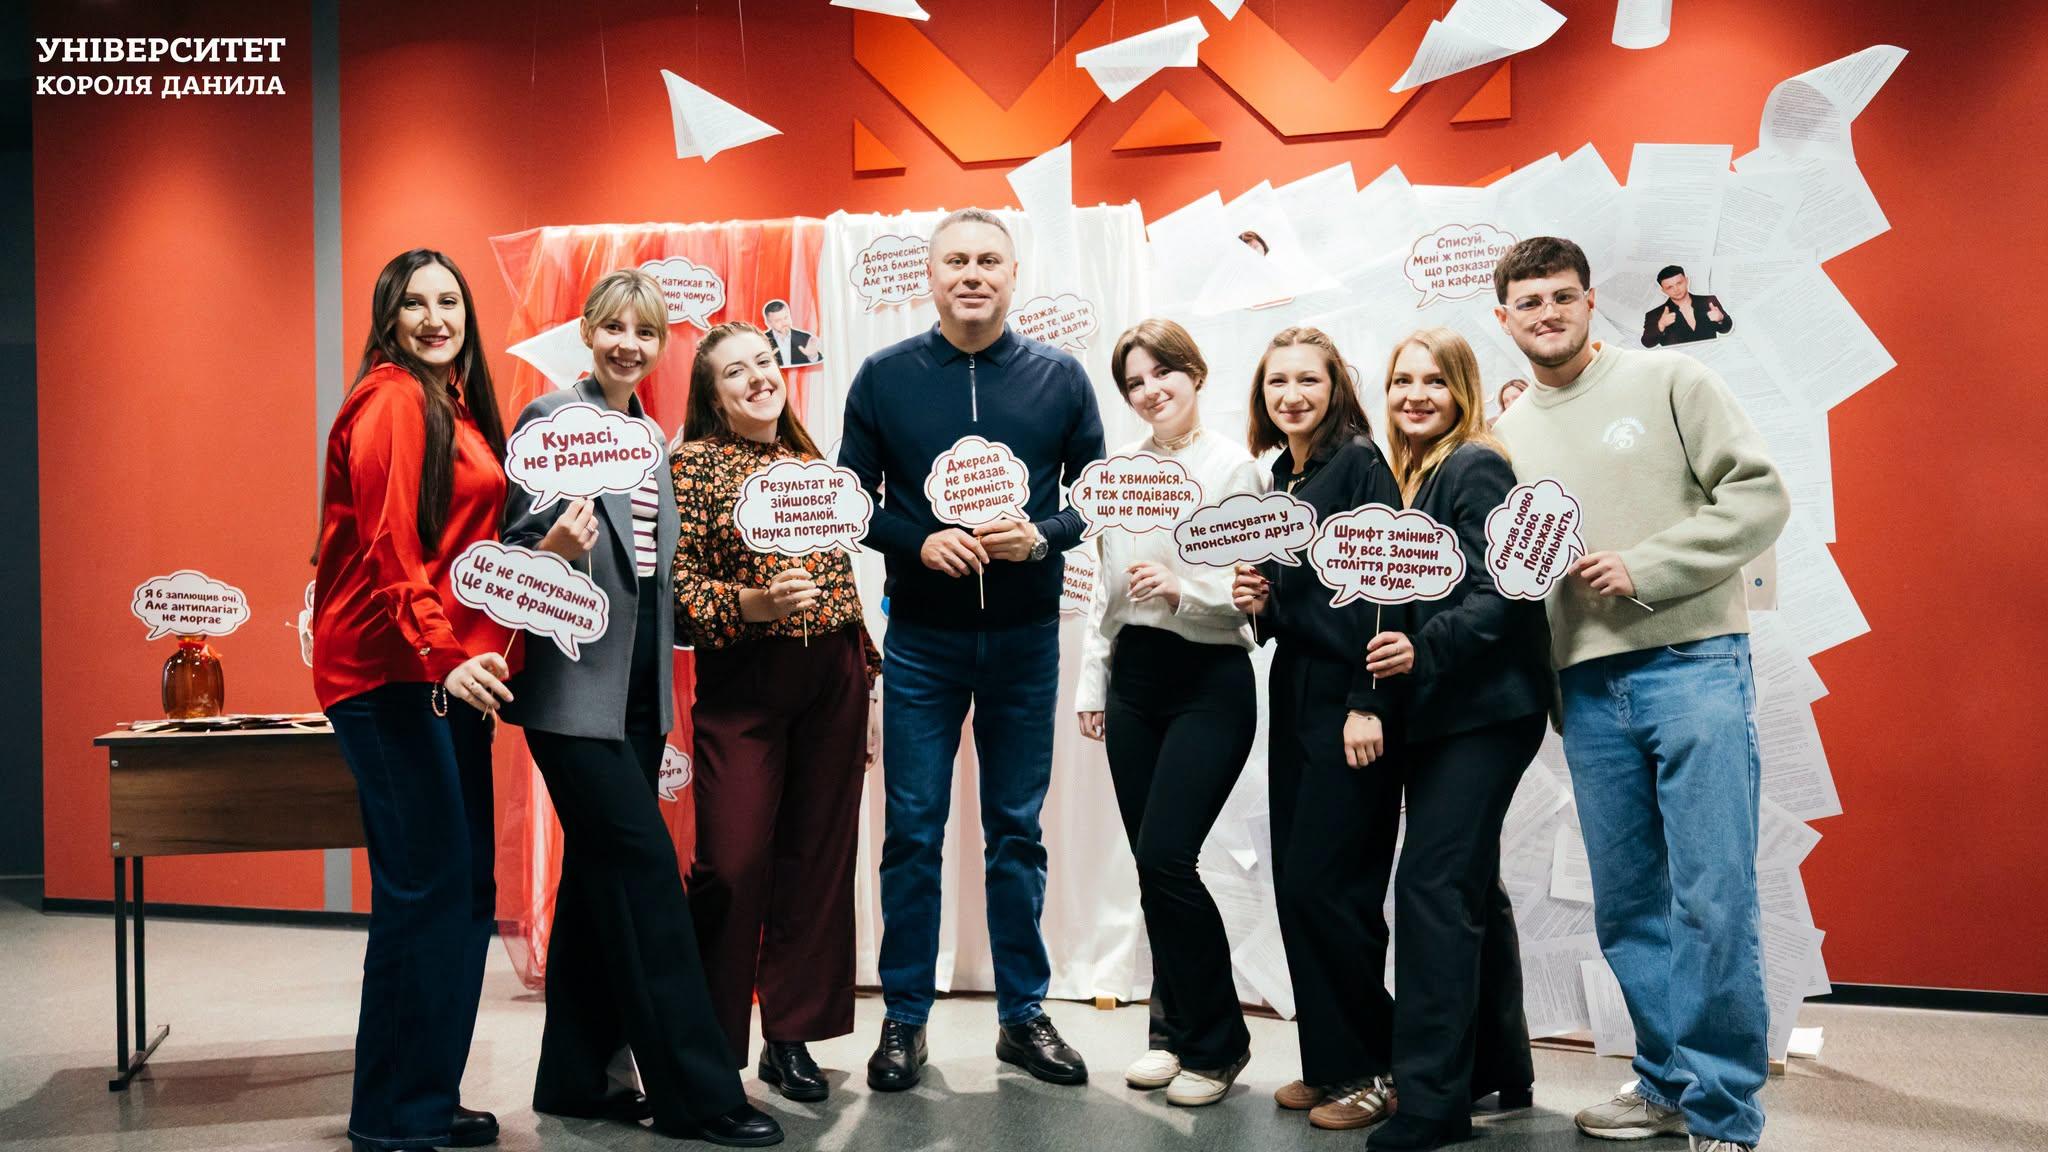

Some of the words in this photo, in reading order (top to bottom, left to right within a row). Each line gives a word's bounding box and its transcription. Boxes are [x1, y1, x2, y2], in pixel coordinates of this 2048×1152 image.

[1437, 232, 1486, 249] Списуй.
[1413, 251, 1439, 266] Мені
[1442, 252, 1452, 262] ж
[1454, 247, 1485, 260] потім
[865, 264, 888, 276] була
[1425, 267, 1442, 277] що
[1446, 259, 1498, 275] розказат
[662, 277, 703, 288] натискав
[863, 277, 881, 287] Але
[883, 275, 895, 283] ти
[896, 282, 922, 295] туди.
[1431, 279, 1445, 289] на
[1448, 273, 1492, 287] кафедр
[683, 291, 716, 304] чомусь
[1061, 313, 1076, 323] що
[1078, 307, 1089, 315] ти
[1048, 329, 1060, 340] це
[542, 426, 618, 452] Кумасі,
[524, 455, 548, 470] не
[554, 447, 652, 472] радимось
[946, 453, 1000, 474] Джерела
[945, 475, 960, 487] не
[963, 465, 1009, 484] вказав.
[1100, 471, 1116, 484] Не
[1119, 471, 1184, 485] хвилюйся.
[760, 478, 825, 494] Результат
[829, 477, 844, 489] не
[943, 479, 1015, 502] Скромність
[771, 491, 838, 509] зійшовся?
[1082, 486, 1092, 500] Я
[1095, 489, 1118, 500] теж
[1122, 487, 1195, 503] сподівався,
[949, 493, 1016, 516] прикрашає
[1097, 506, 1115, 518] що
[1119, 506, 1133, 515] не
[1136, 503, 1180, 520] помічу
[774, 507, 838, 524] Намалюй.
[1190, 526, 1207, 537] Не
[1209, 513, 1276, 534] списувати
[1279, 510, 1289, 522] у
[752, 527, 791, 542] Наука
[794, 522, 861, 538] потерпить.
[1185, 530, 1261, 553] японського
[1264, 521, 1305, 539] друга
[1334, 525, 1384, 542] Шрифт
[1388, 528, 1444, 545] змінив?
[1495, 527, 1520, 571] Списав
[1514, 492, 1534, 526] слово
[1518, 512, 1542, 550] слово.
[1338, 541, 1357, 558] Ну
[1362, 546, 1386, 557] все.
[1389, 544, 1439, 560] Злочин
[1523, 513, 1556, 571] Поважаю
[1535, 509, 1575, 586] стабільність.
[1514, 551, 1524, 560] в
[1326, 557, 1383, 572] століття
[1387, 562, 1453, 577] розкрито
[473, 555, 494, 574] Це
[496, 565, 514, 579] не
[517, 573, 598, 613] списування.
[1360, 574, 1376, 585] не
[1380, 574, 1415, 591] буде.
[145, 589, 153, 598] Я
[166, 591, 219, 601] заплющив
[221, 595, 239, 603] очі.
[461, 571, 483, 590] Це
[485, 582, 514, 601] вже
[516, 592, 595, 632] франшиза.
[145, 601, 168, 611] Але
[171, 602, 239, 615] антиплагіат
[162, 613, 176, 622] не
[180, 615, 221, 625] моргає
[665, 758, 672, 768] у
[659, 767, 682, 780] руга
